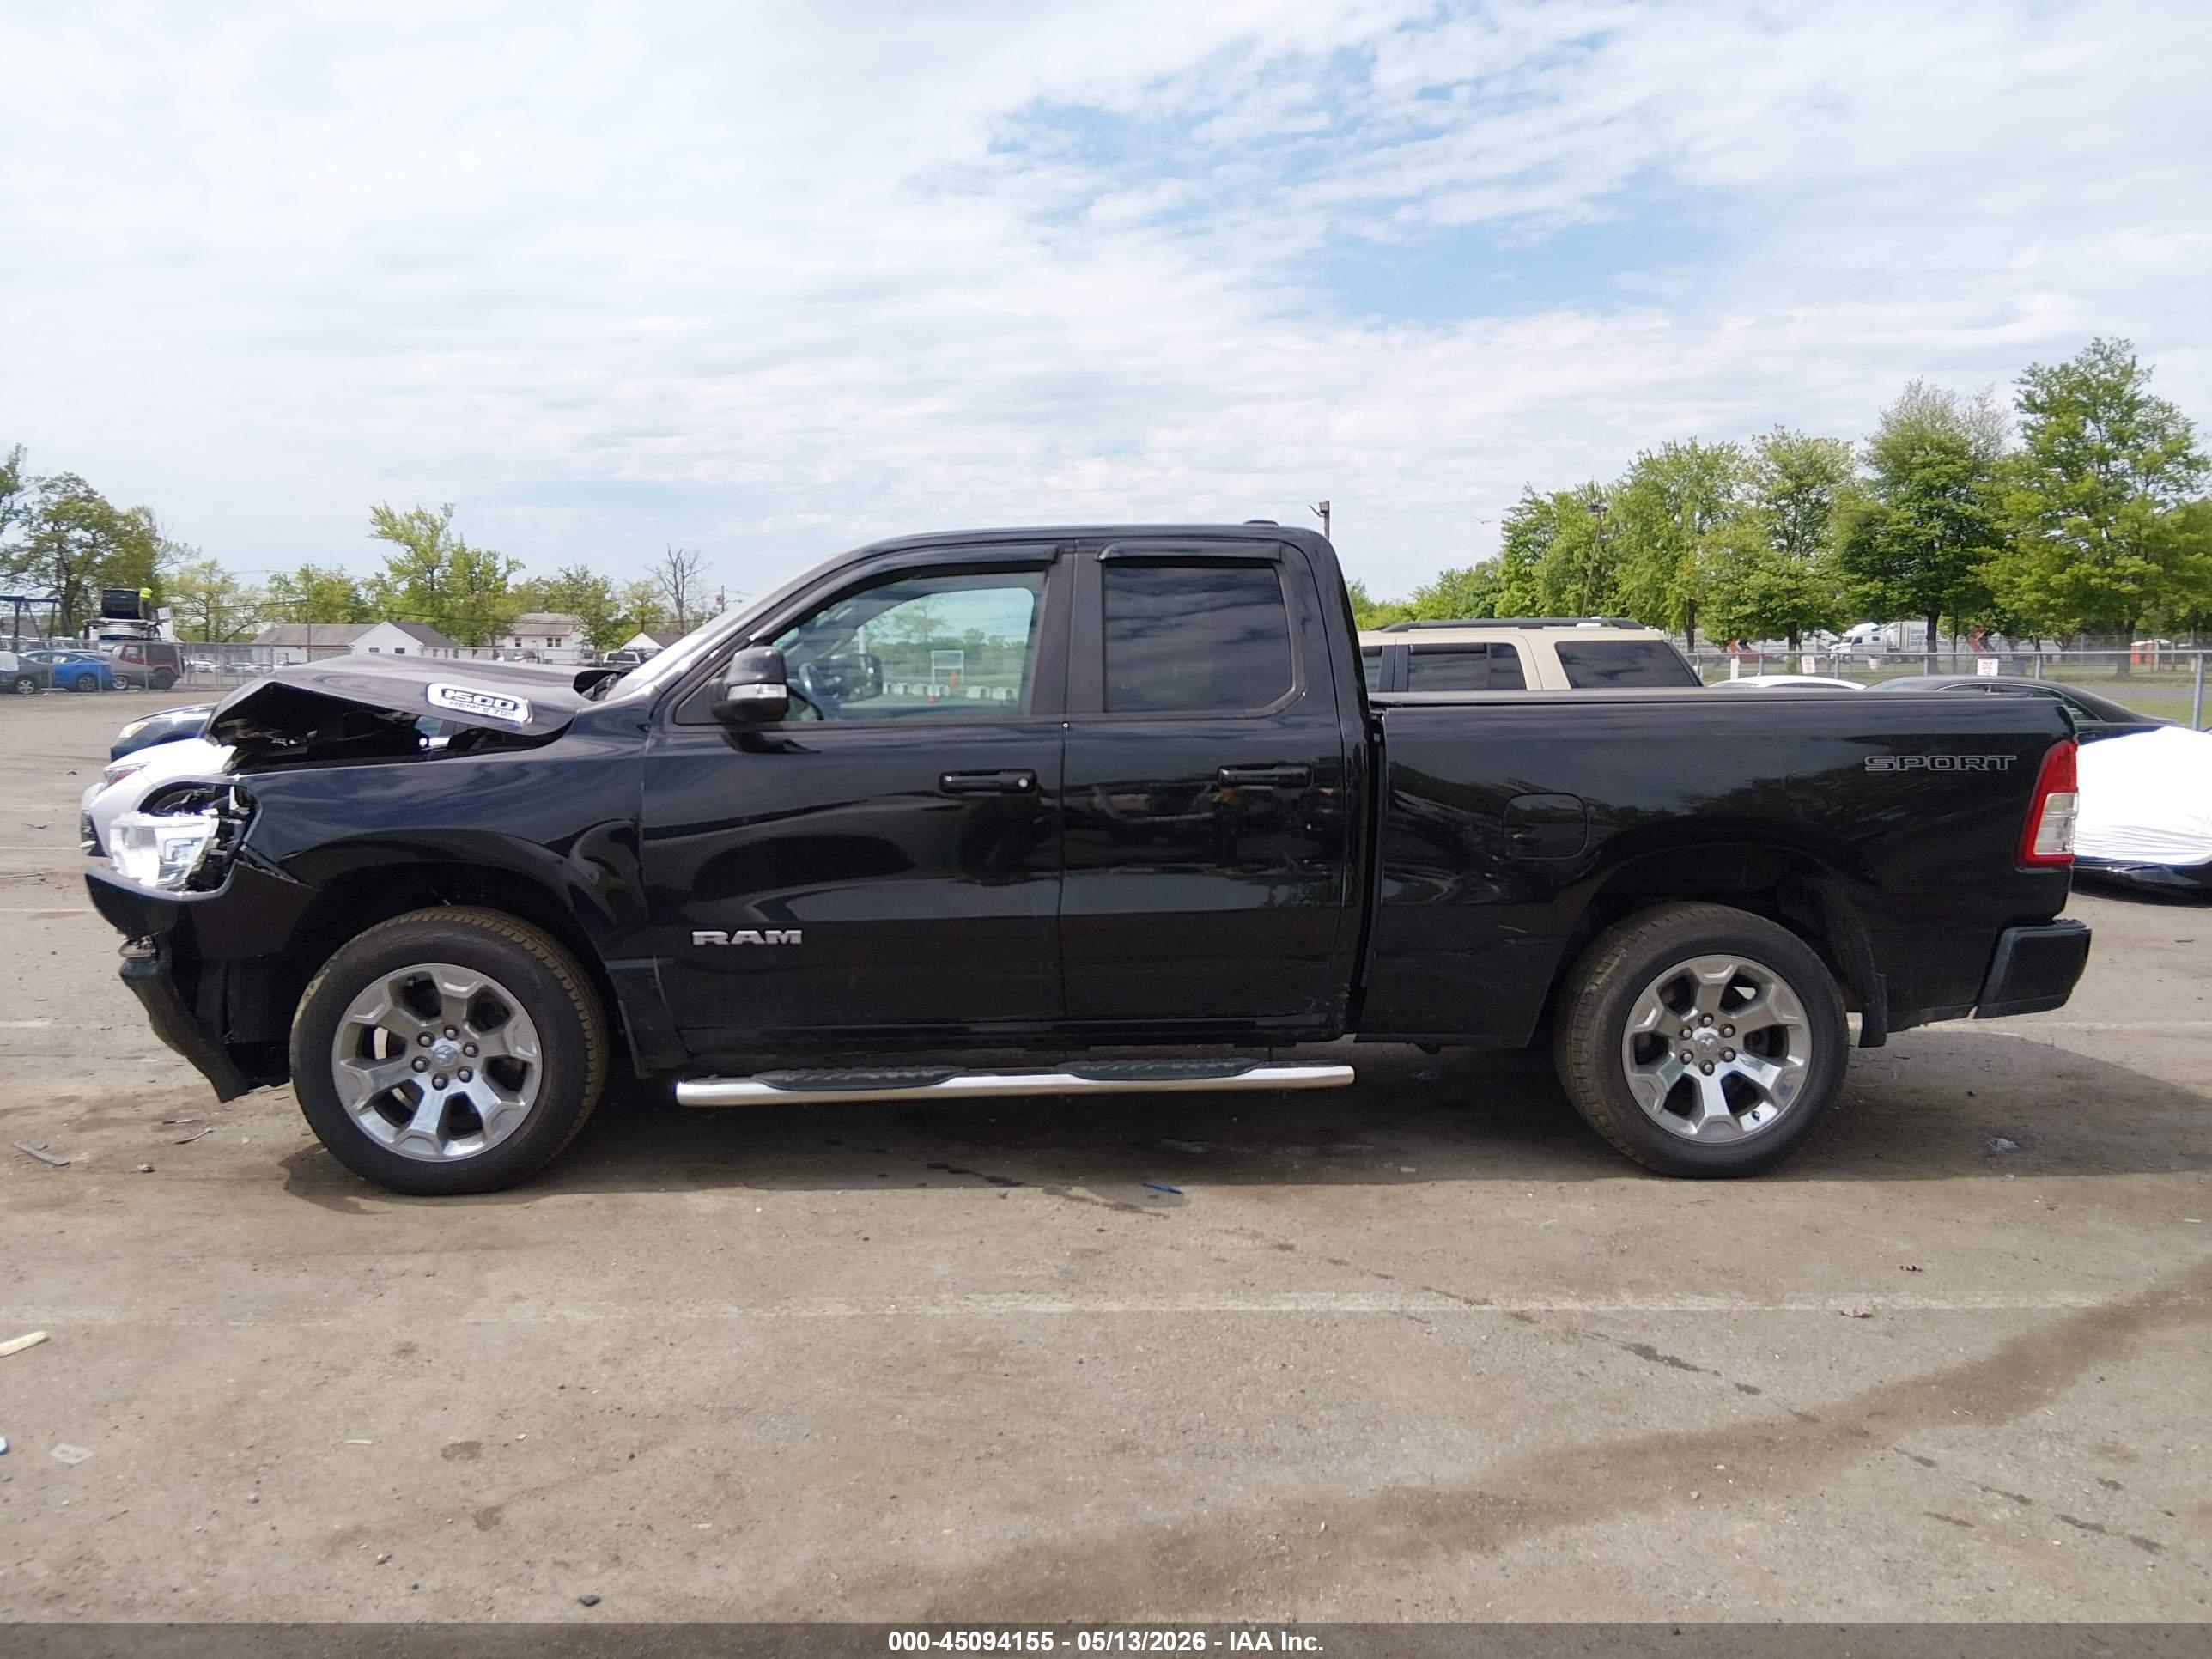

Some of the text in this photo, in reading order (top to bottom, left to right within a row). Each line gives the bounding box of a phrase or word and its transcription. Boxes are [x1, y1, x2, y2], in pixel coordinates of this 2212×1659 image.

[443, 689, 516, 711] 1500
[1864, 755, 2017, 771] SPORT
[692, 930, 803, 945] RAM
